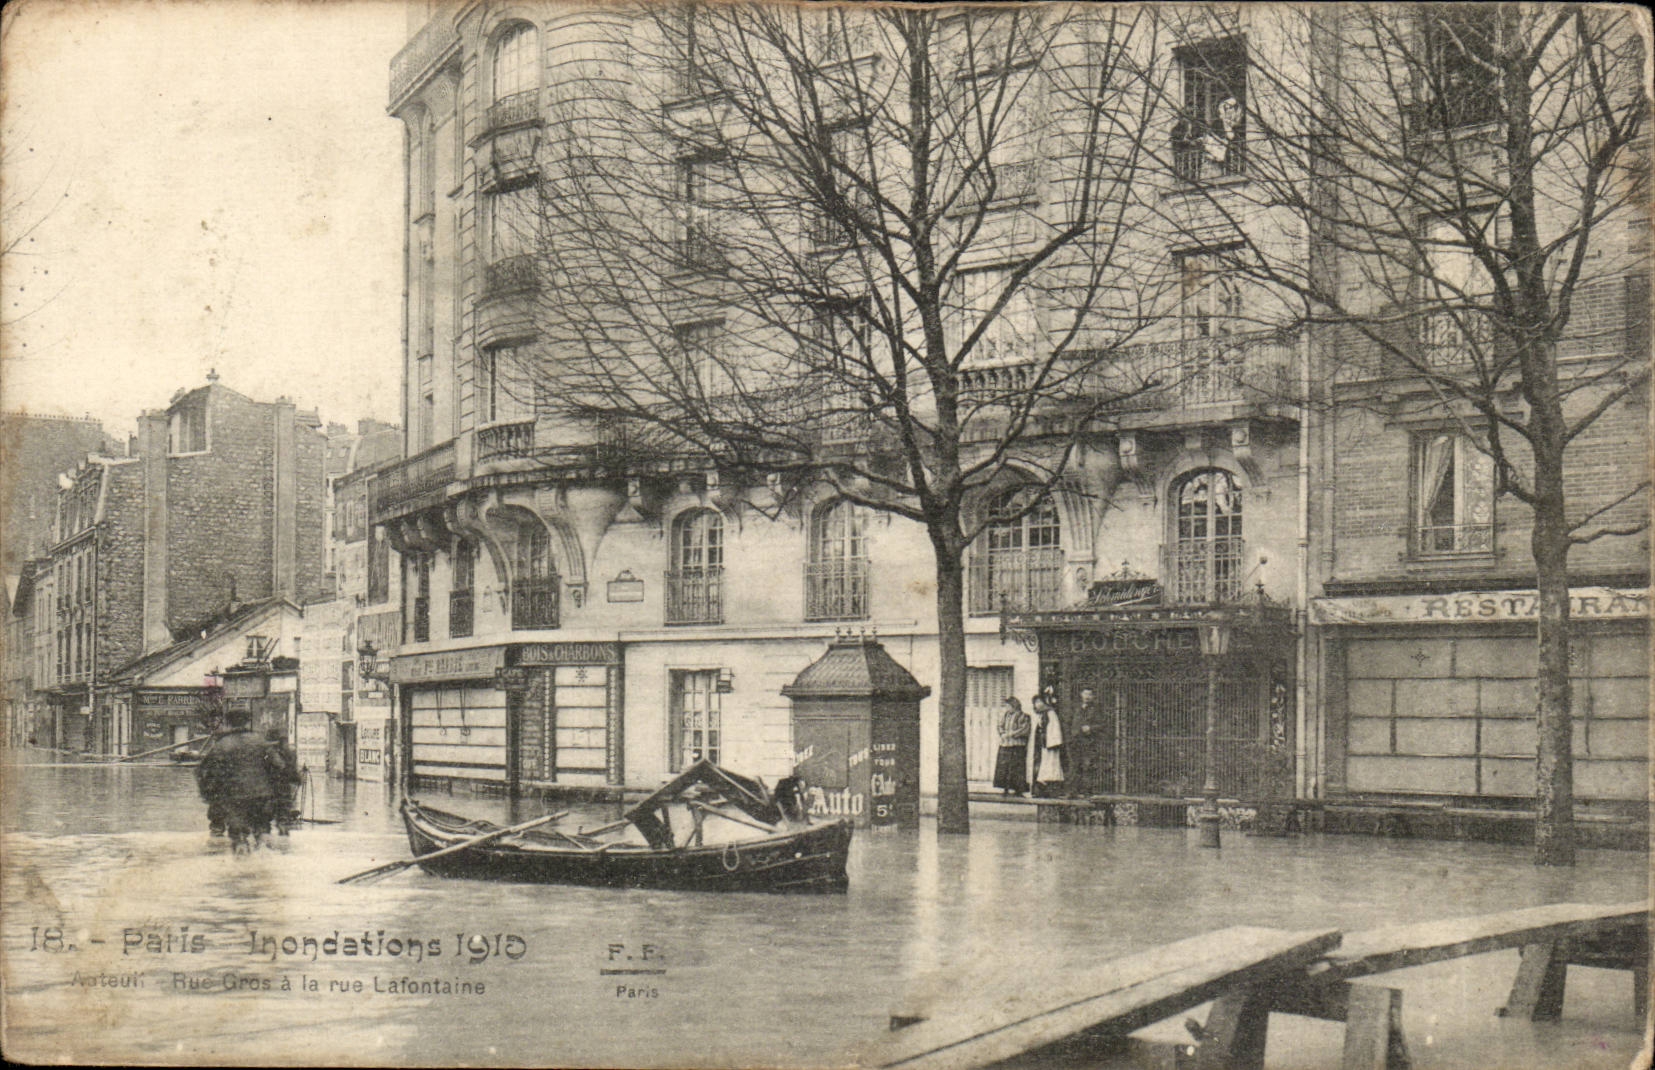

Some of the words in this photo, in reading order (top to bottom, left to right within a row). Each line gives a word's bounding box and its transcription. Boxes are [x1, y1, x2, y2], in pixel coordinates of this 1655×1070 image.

[521, 645, 547, 661] BOIS
[555, 643, 617, 661] CHARBONS
[360, 750, 381, 763] BLANC
